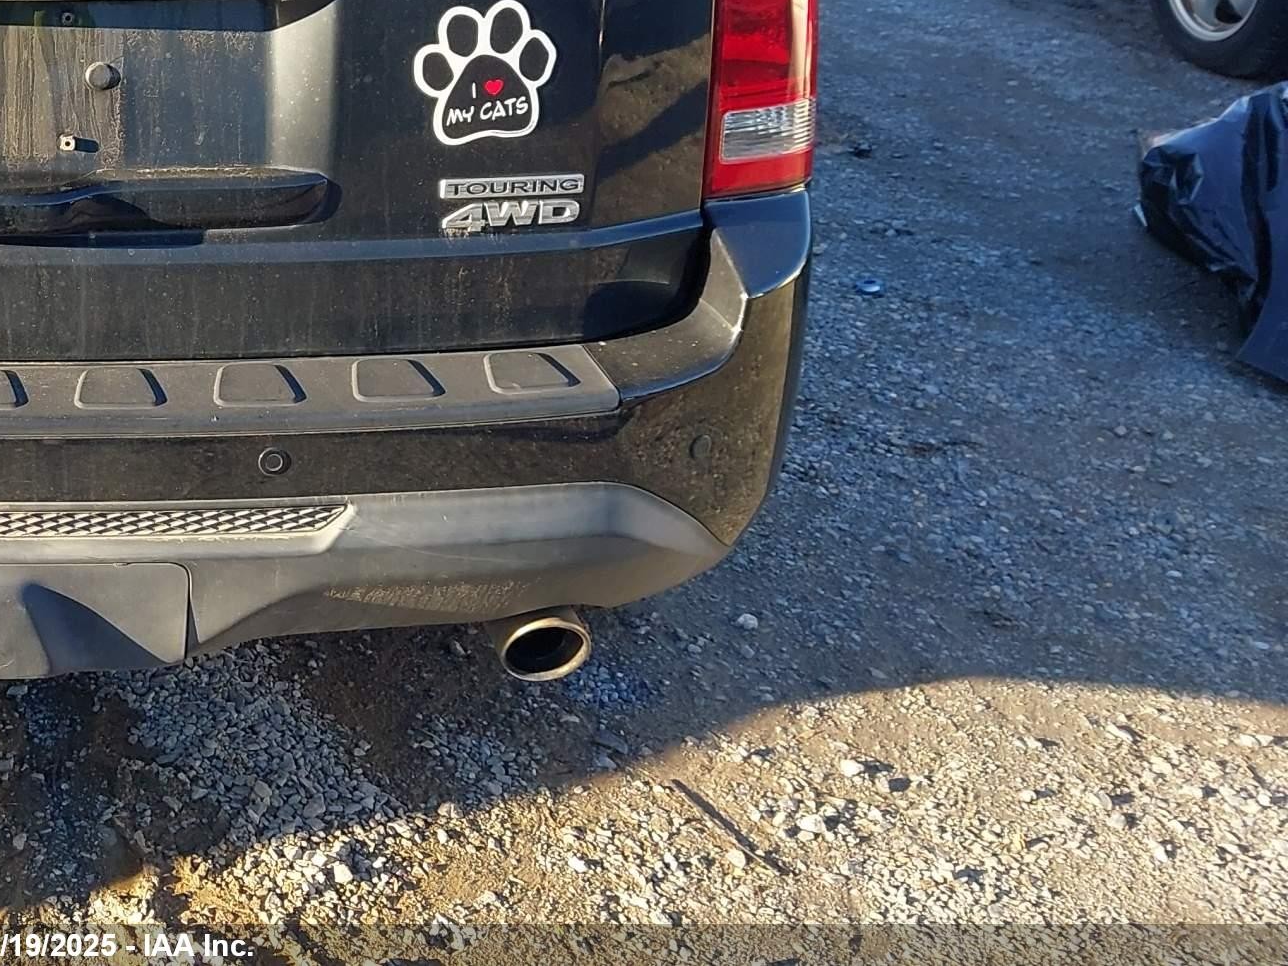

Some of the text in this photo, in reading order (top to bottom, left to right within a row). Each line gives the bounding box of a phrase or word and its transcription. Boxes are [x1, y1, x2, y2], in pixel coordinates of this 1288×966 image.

[471, 82, 477, 99] I
[480, 96, 529, 121] CATS
[447, 177, 580, 196] TOURING
[442, 199, 580, 232] 4WD
